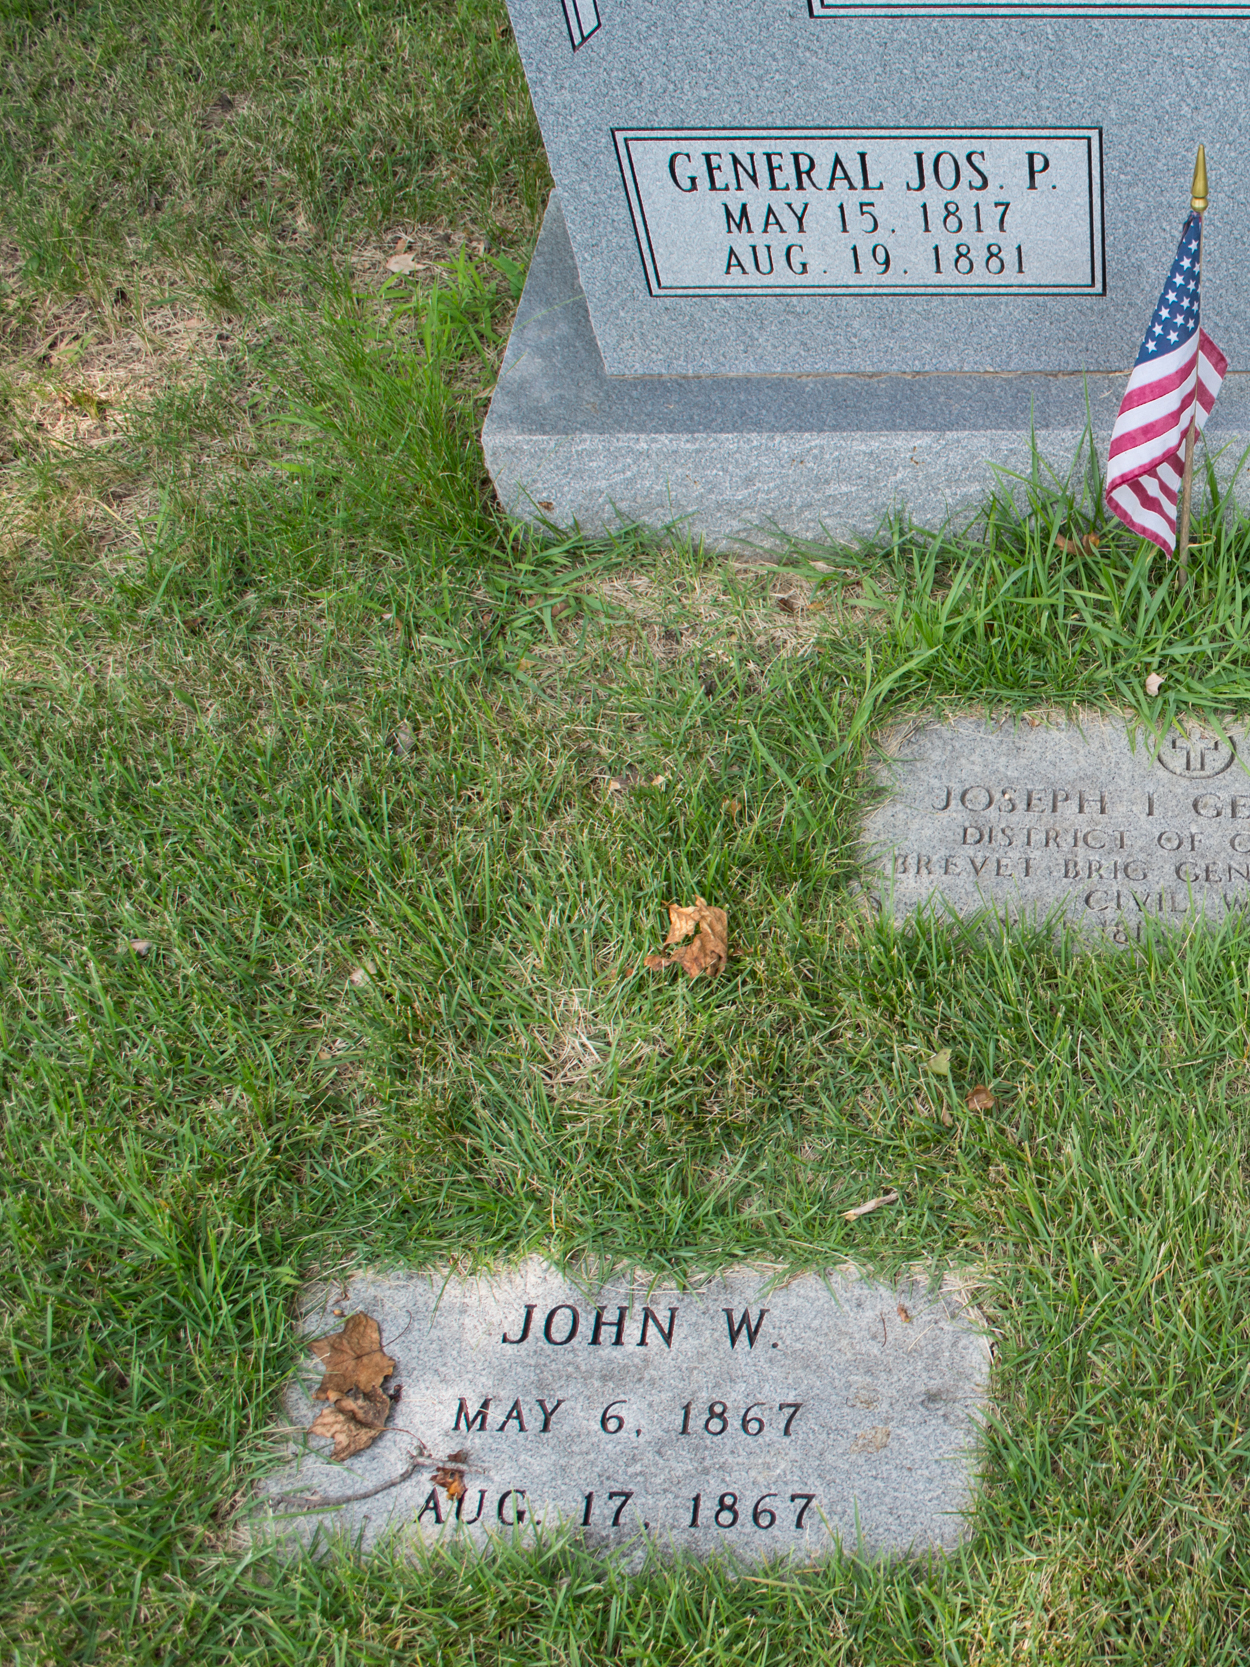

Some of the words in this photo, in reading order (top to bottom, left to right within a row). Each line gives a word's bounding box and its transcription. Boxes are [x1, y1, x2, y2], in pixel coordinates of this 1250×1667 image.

[668, 151, 884, 192] GENERAL
[906, 151, 1004, 192] JOS.
[1026, 151, 1058, 190] P.
[722, 202, 809, 234] MAY
[921, 201, 1011, 233] 1817
[724, 243, 828, 275] AUG.
[932, 243, 1026, 275] 1881
[931, 785, 1108, 815] JOSEPH
[962, 824, 1129, 850] DISTRICT
[1157, 830, 1203, 851] OF
[893, 853, 1037, 878] BREVET
[1063, 858, 1148, 882] BRIG
[1175, 861, 1250, 883] GEN
[1084, 889, 1188, 913] CIVIL
[502, 1304, 679, 1349] JOHN
[722, 1307, 779, 1350] W.
[451, 1397, 566, 1433] MAY
[600, 1400, 642, 1438] 6,
[679, 1401, 803, 1437] 1867
[413, 1487, 542, 1527] AUG.
[580, 1490, 650, 1530] 17,
[688, 1492, 816, 1530] 1867
